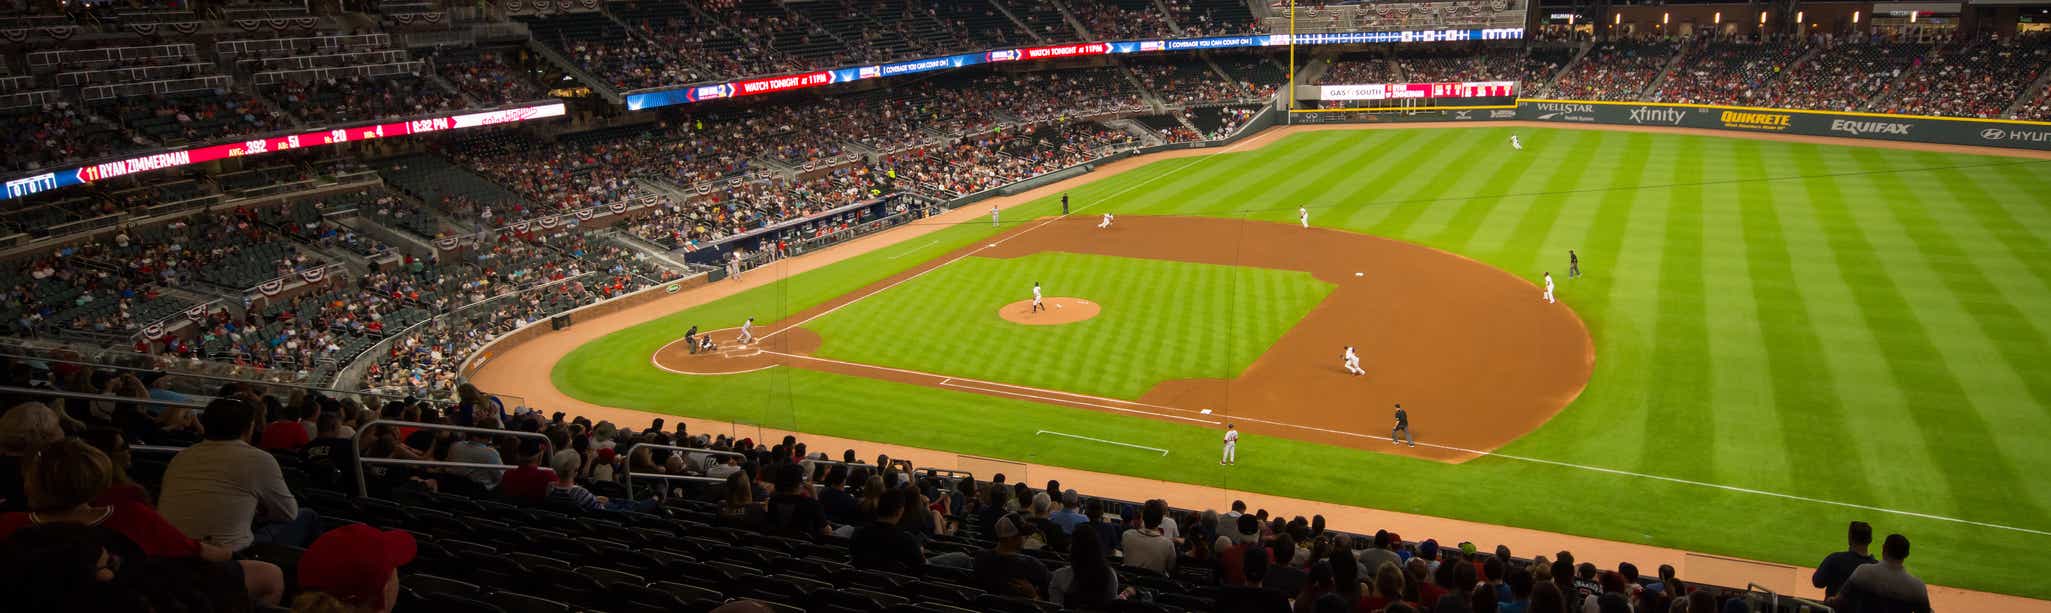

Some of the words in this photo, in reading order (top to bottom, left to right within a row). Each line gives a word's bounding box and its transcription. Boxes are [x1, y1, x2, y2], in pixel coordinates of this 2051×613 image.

[1029, 48, 1050, 58] WATCH
[1051, 46, 1077, 56] TONIGHT
[744, 80, 769, 93] WATCH
[769, 76, 800, 90] TONIGHT
[808, 73, 827, 85] 11PM
[1330, 89, 1346, 97] GAS
[1355, 88, 1382, 97] SOUTH
[1537, 102, 1594, 114] WELLSTAR
[1629, 106, 1687, 125] xfinity
[412, 119, 434, 133] 8:32
[434, 117, 449, 131] PM
[1720, 110, 1791, 126] QUIKRETE
[1830, 119, 1912, 135] EQUIFAX
[287, 135, 300, 149] 51
[332, 129, 347, 143] 20
[376, 125, 384, 137] 4
[86, 166, 100, 181] 11
[99, 160, 127, 179] RYAN
[127, 150, 191, 173] ZIMMERMAN
